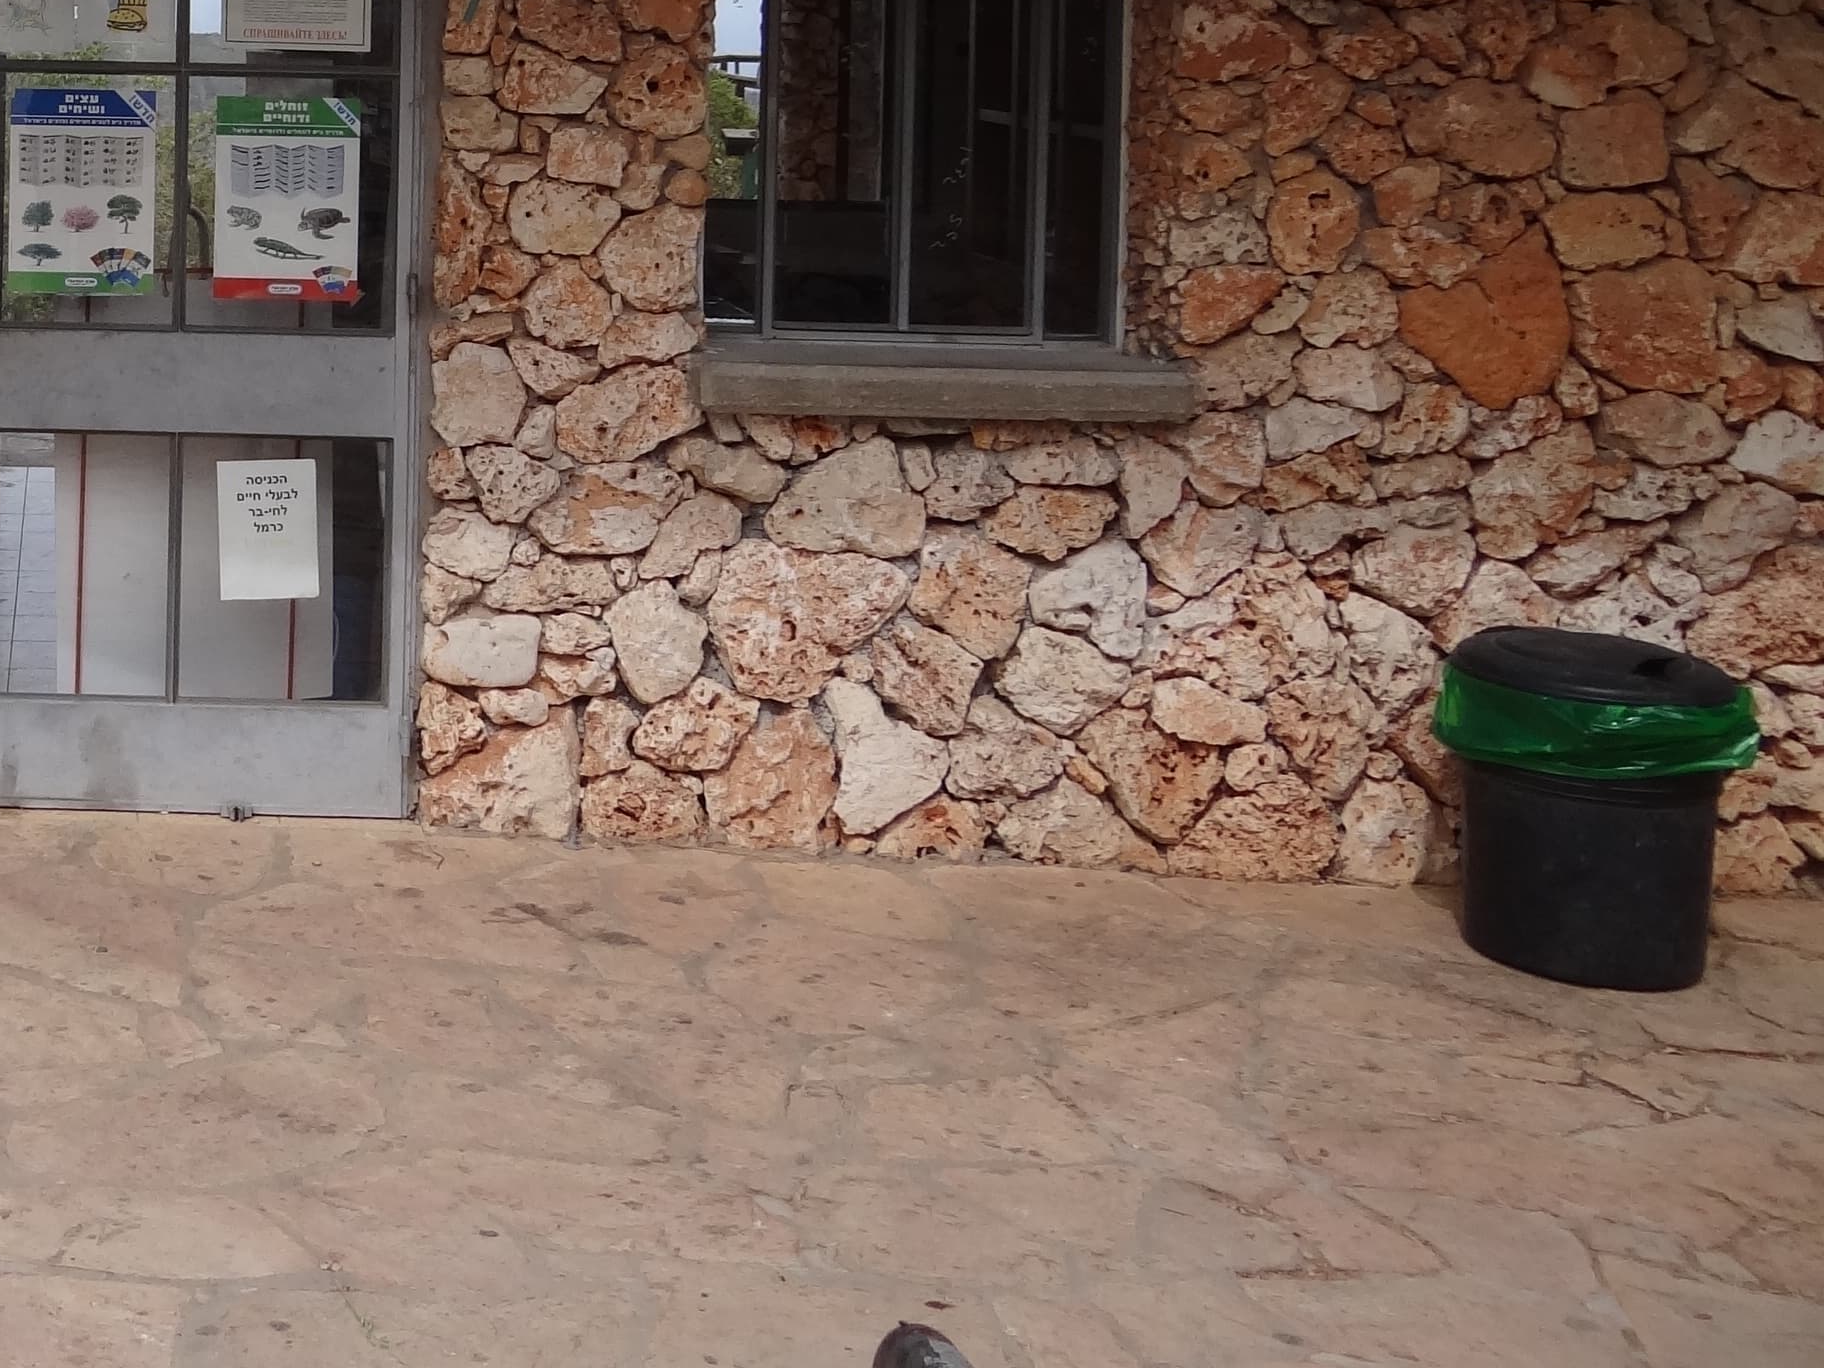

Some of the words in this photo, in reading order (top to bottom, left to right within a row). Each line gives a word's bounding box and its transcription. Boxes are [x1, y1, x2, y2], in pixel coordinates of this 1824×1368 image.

[242, 27, 315, 40] СПРАШИВАЙТЕ
[316, 29, 348, 41] ЗДЕСЬ!
[64, 94, 99, 104] עצים
[58, 104, 105, 114] ושיחים
[128, 95, 156, 124] חדש!
[264, 100, 309, 111] זוחלים
[263, 113, 310, 123] ודוחיים
[333, 102, 357, 126] חדש!
[246, 474, 288, 485] הכניסה
[236, 491, 261, 502] חיים
[265, 488, 298, 501] לבעלי
[248, 504, 288, 517] לחי-בר
[253, 522, 284, 533] כרמל
